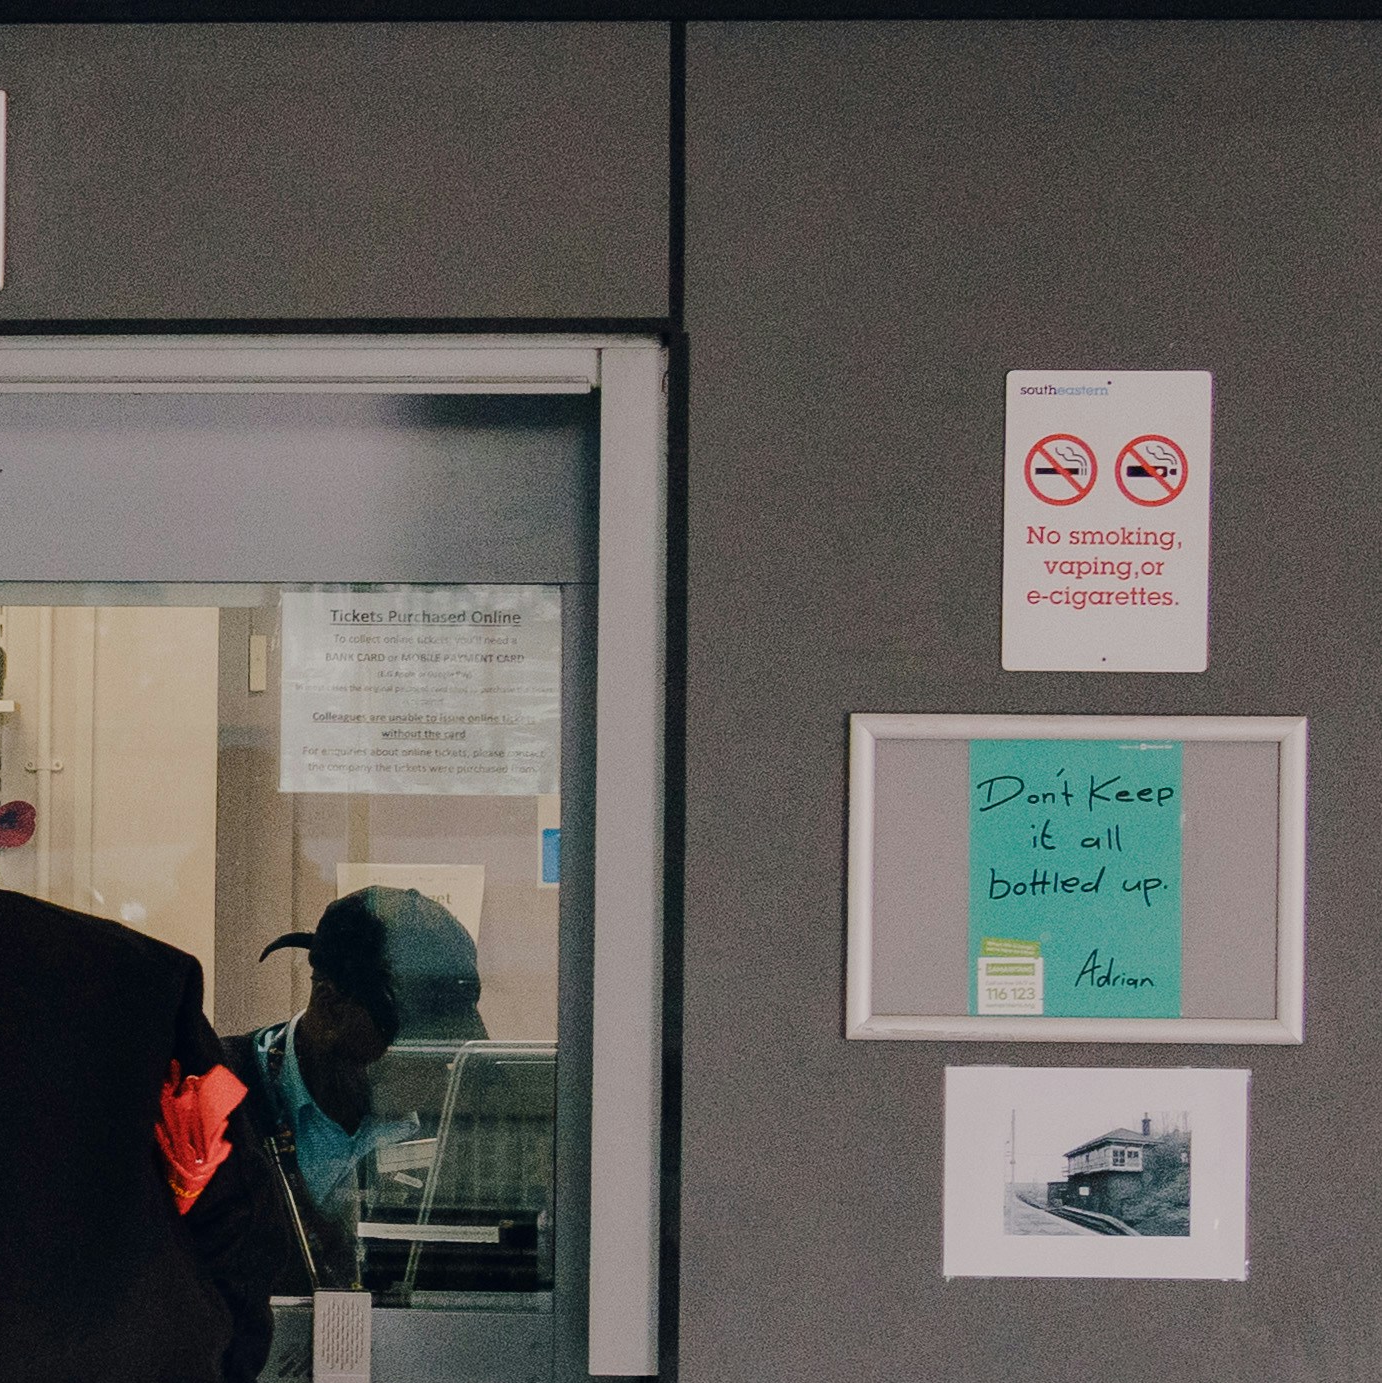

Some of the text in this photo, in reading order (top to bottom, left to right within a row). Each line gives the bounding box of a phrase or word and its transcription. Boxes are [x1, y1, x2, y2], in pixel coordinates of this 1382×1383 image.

[1020, 385, 1108, 396] southeastern
[1026, 525, 1182, 551] No smoking,
[1026, 586, 1180, 612] e-cigarettes.
[330, 610, 521, 624] Tickets Purchased Online
[977, 768, 1174, 812] Don't Keep
[1030, 819, 1122, 851] it all
[989, 866, 1168, 906] bottled up.
[1075, 949, 1154, 988] Adrian
[986, 987, 1035, 1000] 116 123
